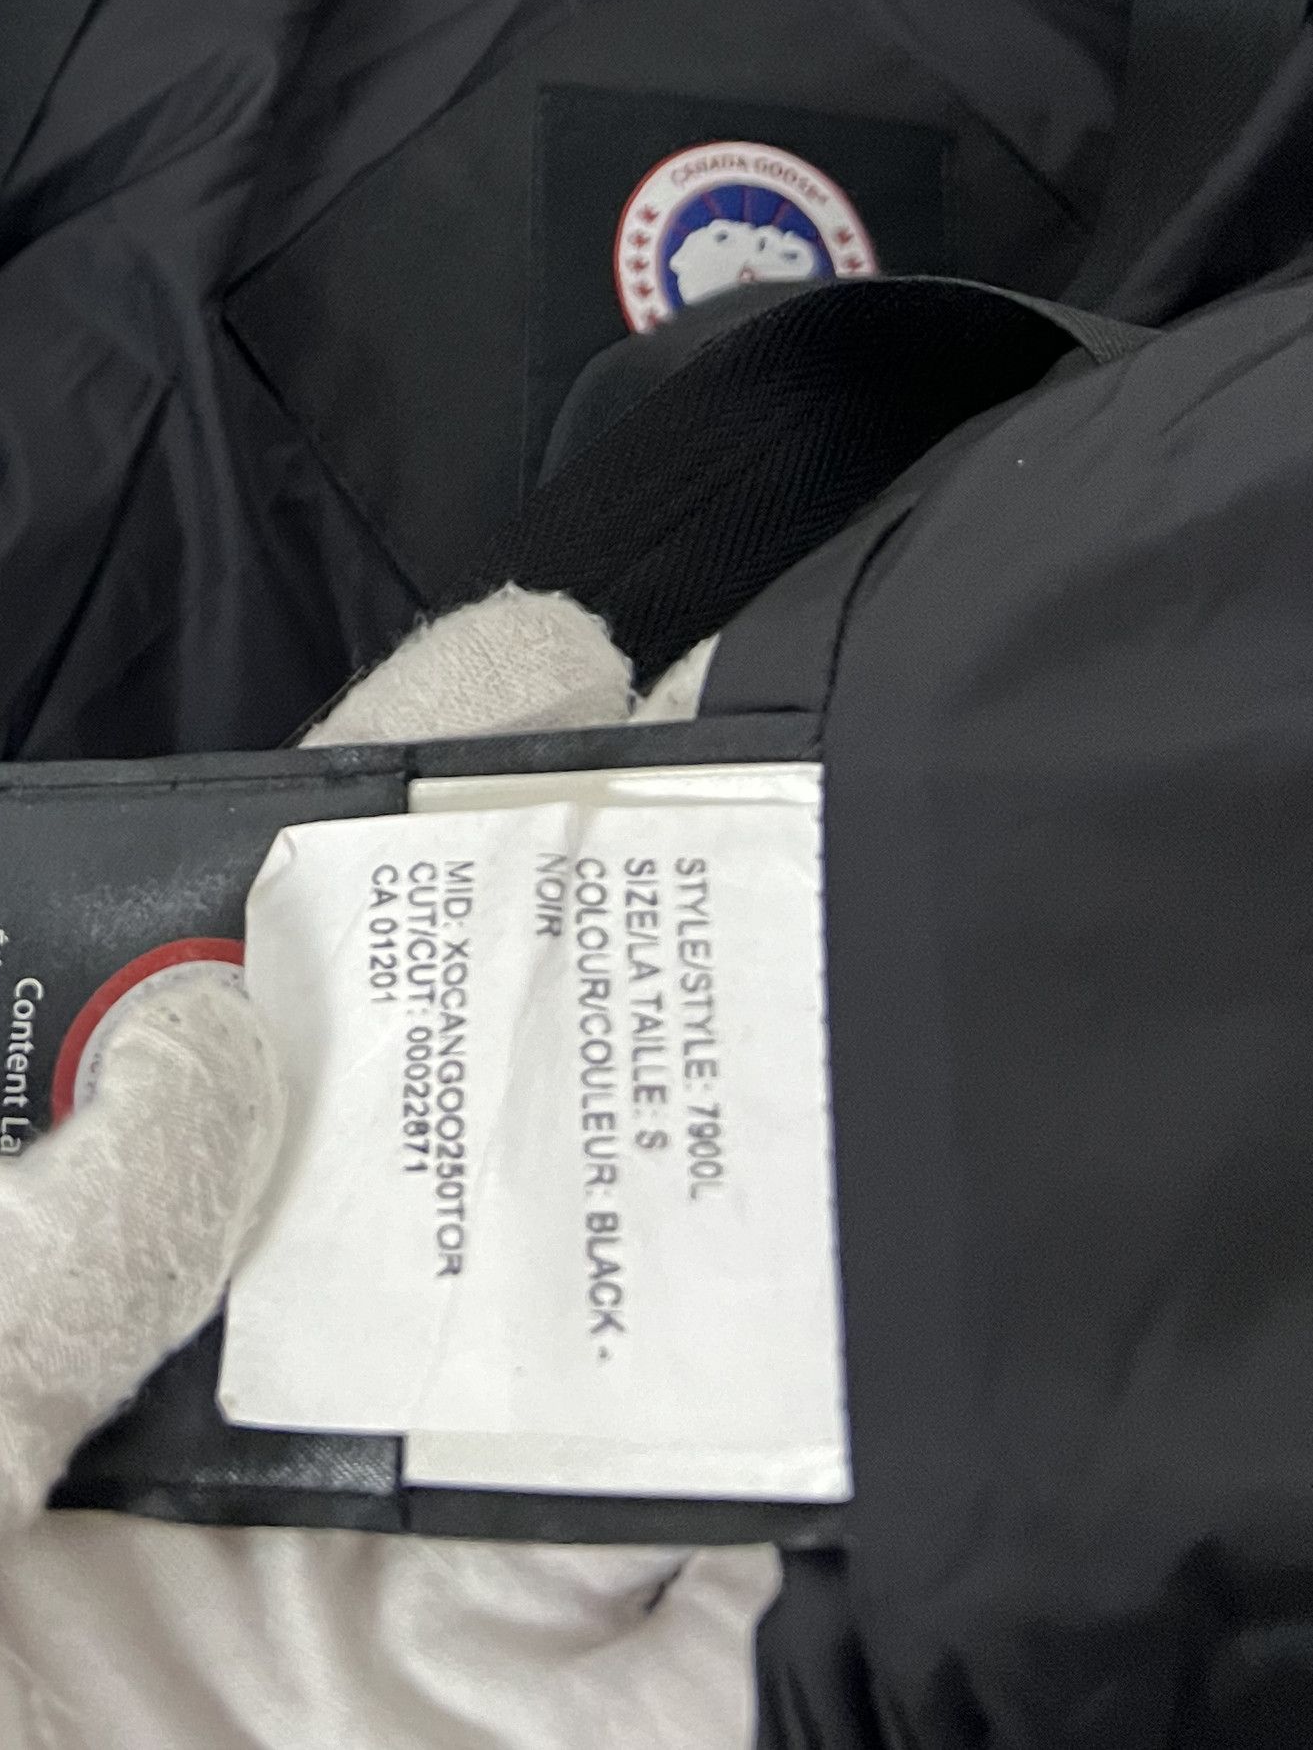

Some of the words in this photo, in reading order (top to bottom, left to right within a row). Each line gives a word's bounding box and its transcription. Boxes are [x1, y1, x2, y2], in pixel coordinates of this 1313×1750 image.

[670, 153, 747, 187] CANADA
[754, 156, 818, 198] GOOSE
[370, 864, 399, 908] CA
[408, 861, 437, 1015] CUT/CUT:
[444, 861, 473, 927] MID:
[535, 852, 569, 938] NOIR
[624, 857, 663, 983] SIZE/LA
[369, 917, 399, 1002] 01201
[675, 857, 718, 1090] STYLE/STYLE:
[2, 977, 44, 1108] Content
[575, 857, 617, 1197] COLOUR/COULEUR:
[629, 990, 668, 1119] TAILLE:
[0, 1116, 30, 1154] La
[403, 1026, 433, 1172] 00022871
[634, 1128, 669, 1150] S
[687, 1101, 725, 1200] 7900L
[586, 1212, 625, 1334] BLACK
